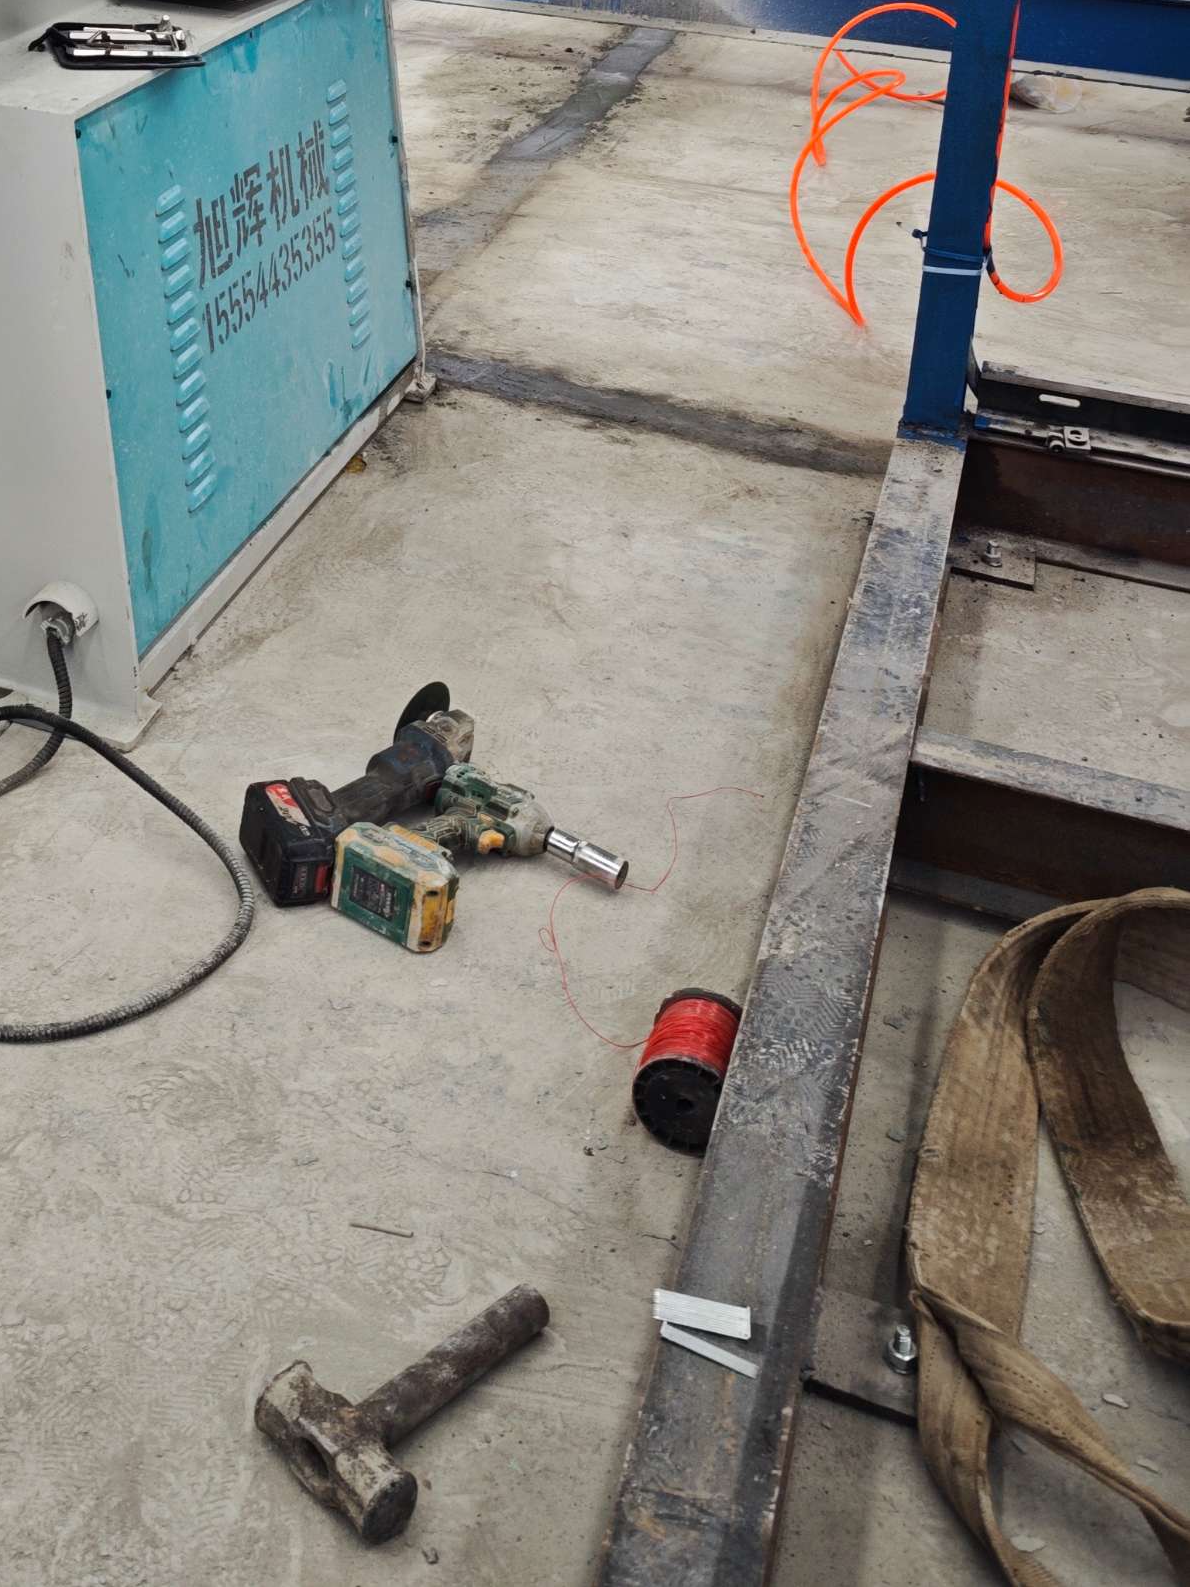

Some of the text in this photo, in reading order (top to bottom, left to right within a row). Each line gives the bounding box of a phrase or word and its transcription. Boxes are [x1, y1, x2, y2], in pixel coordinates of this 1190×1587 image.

[193, 119, 330, 290] 旭辉机械
[202, 207, 336, 354] 15554435355
